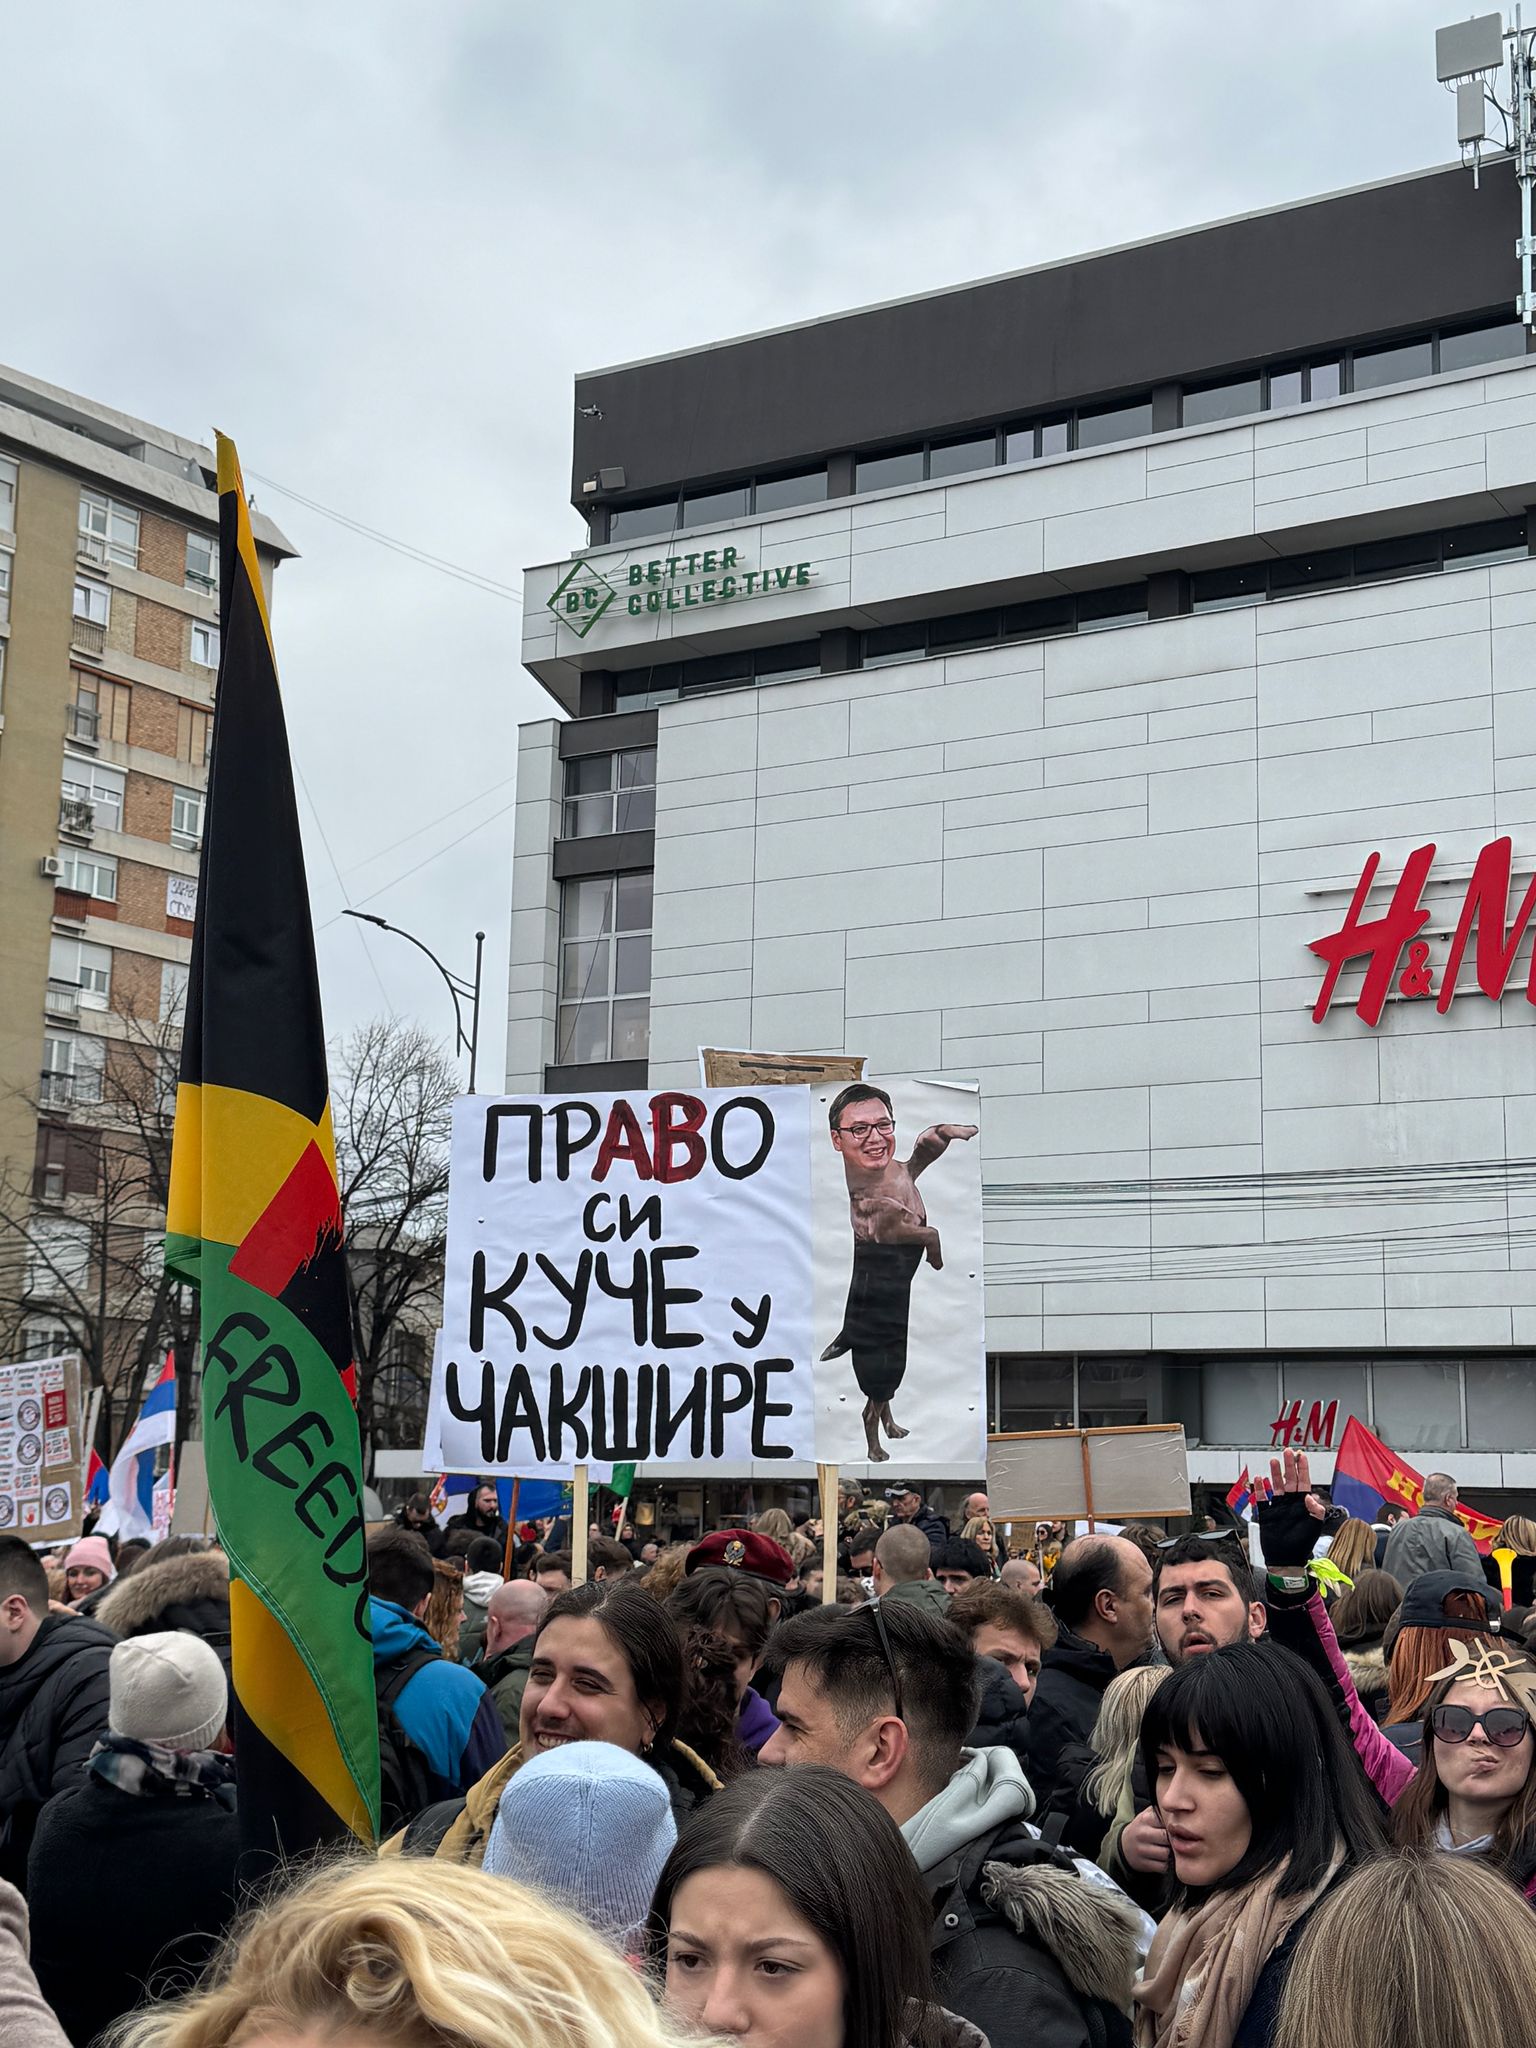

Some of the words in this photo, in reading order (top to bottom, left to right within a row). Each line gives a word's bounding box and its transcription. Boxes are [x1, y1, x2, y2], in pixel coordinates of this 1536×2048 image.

[628, 546, 737, 586] BETTER
[628, 562, 812, 615] COLLECTIVE
[566, 588, 599, 613] BC
[482, 1092, 776, 1184] ПРАВО
[469, 1246, 704, 1352] КУЧЕ
[446, 1358, 795, 1463] ЧАКШИРЕ
[1270, 1400, 1340, 1448] H&M
